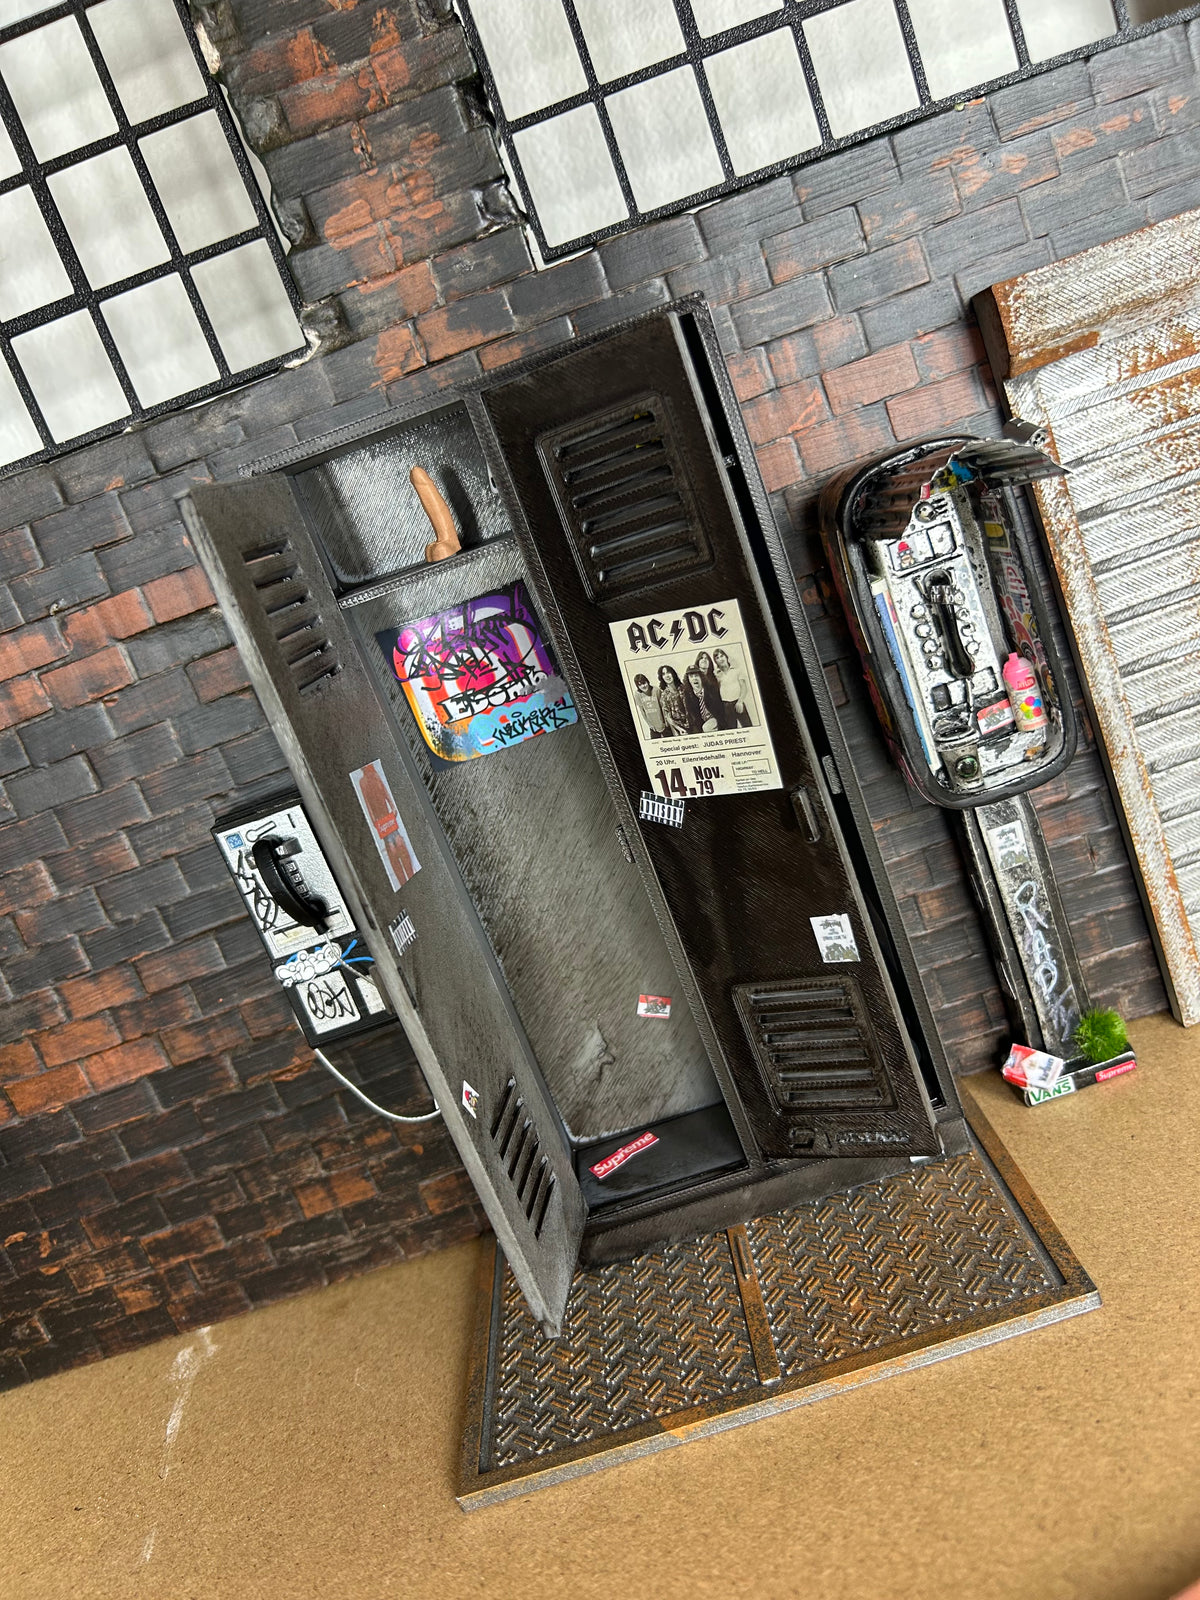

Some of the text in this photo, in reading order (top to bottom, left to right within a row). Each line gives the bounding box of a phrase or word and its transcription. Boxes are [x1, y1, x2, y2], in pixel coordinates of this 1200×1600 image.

[626, 608, 728, 653] AC/DC
[659, 745, 680, 753] Special
[681, 743, 699, 752] guest:
[703, 739, 724, 748] JUDAS
[725, 737, 747, 745] PRIEST
[731, 750, 762, 758] Hannover
[693, 766, 724, 780] Nov.
[696, 780, 714, 795] 79
[1098, 1062, 1135, 1081] Supreme
[1030, 1079, 1072, 1102] VANS
[593, 1132, 654, 1175] Supreme
